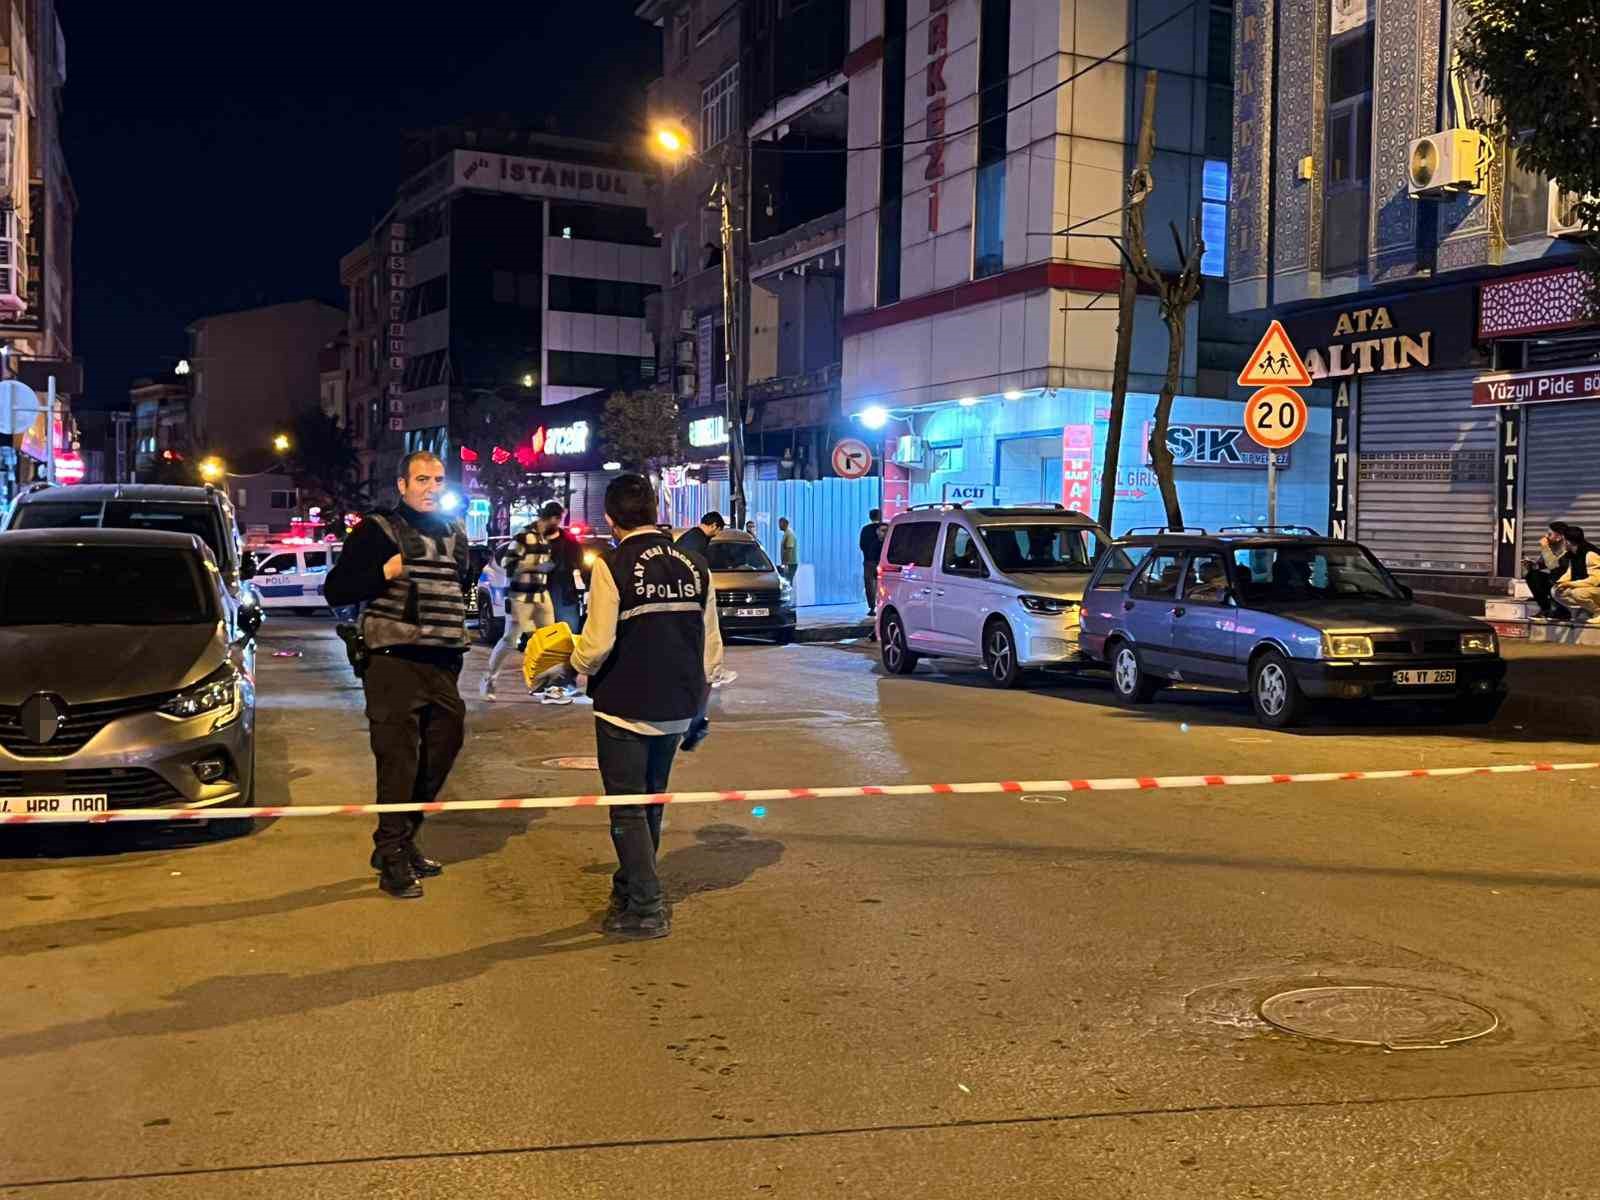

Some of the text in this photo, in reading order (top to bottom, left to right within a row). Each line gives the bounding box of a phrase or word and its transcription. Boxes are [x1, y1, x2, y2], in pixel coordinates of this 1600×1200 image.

[1333, 307, 1393, 336] ATA
[1304, 331, 1431, 380] ALTIN
[1487, 380, 1533, 402] Yüzyıl
[1538, 377, 1574, 396] Pide
[1257, 402, 1295, 428] 20
[1332, 380, 1349, 540] ALTIN
[1502, 405, 1520, 544] LTIN
[646, 579, 696, 598] POLİS
[1398, 671, 1410, 682] 34
